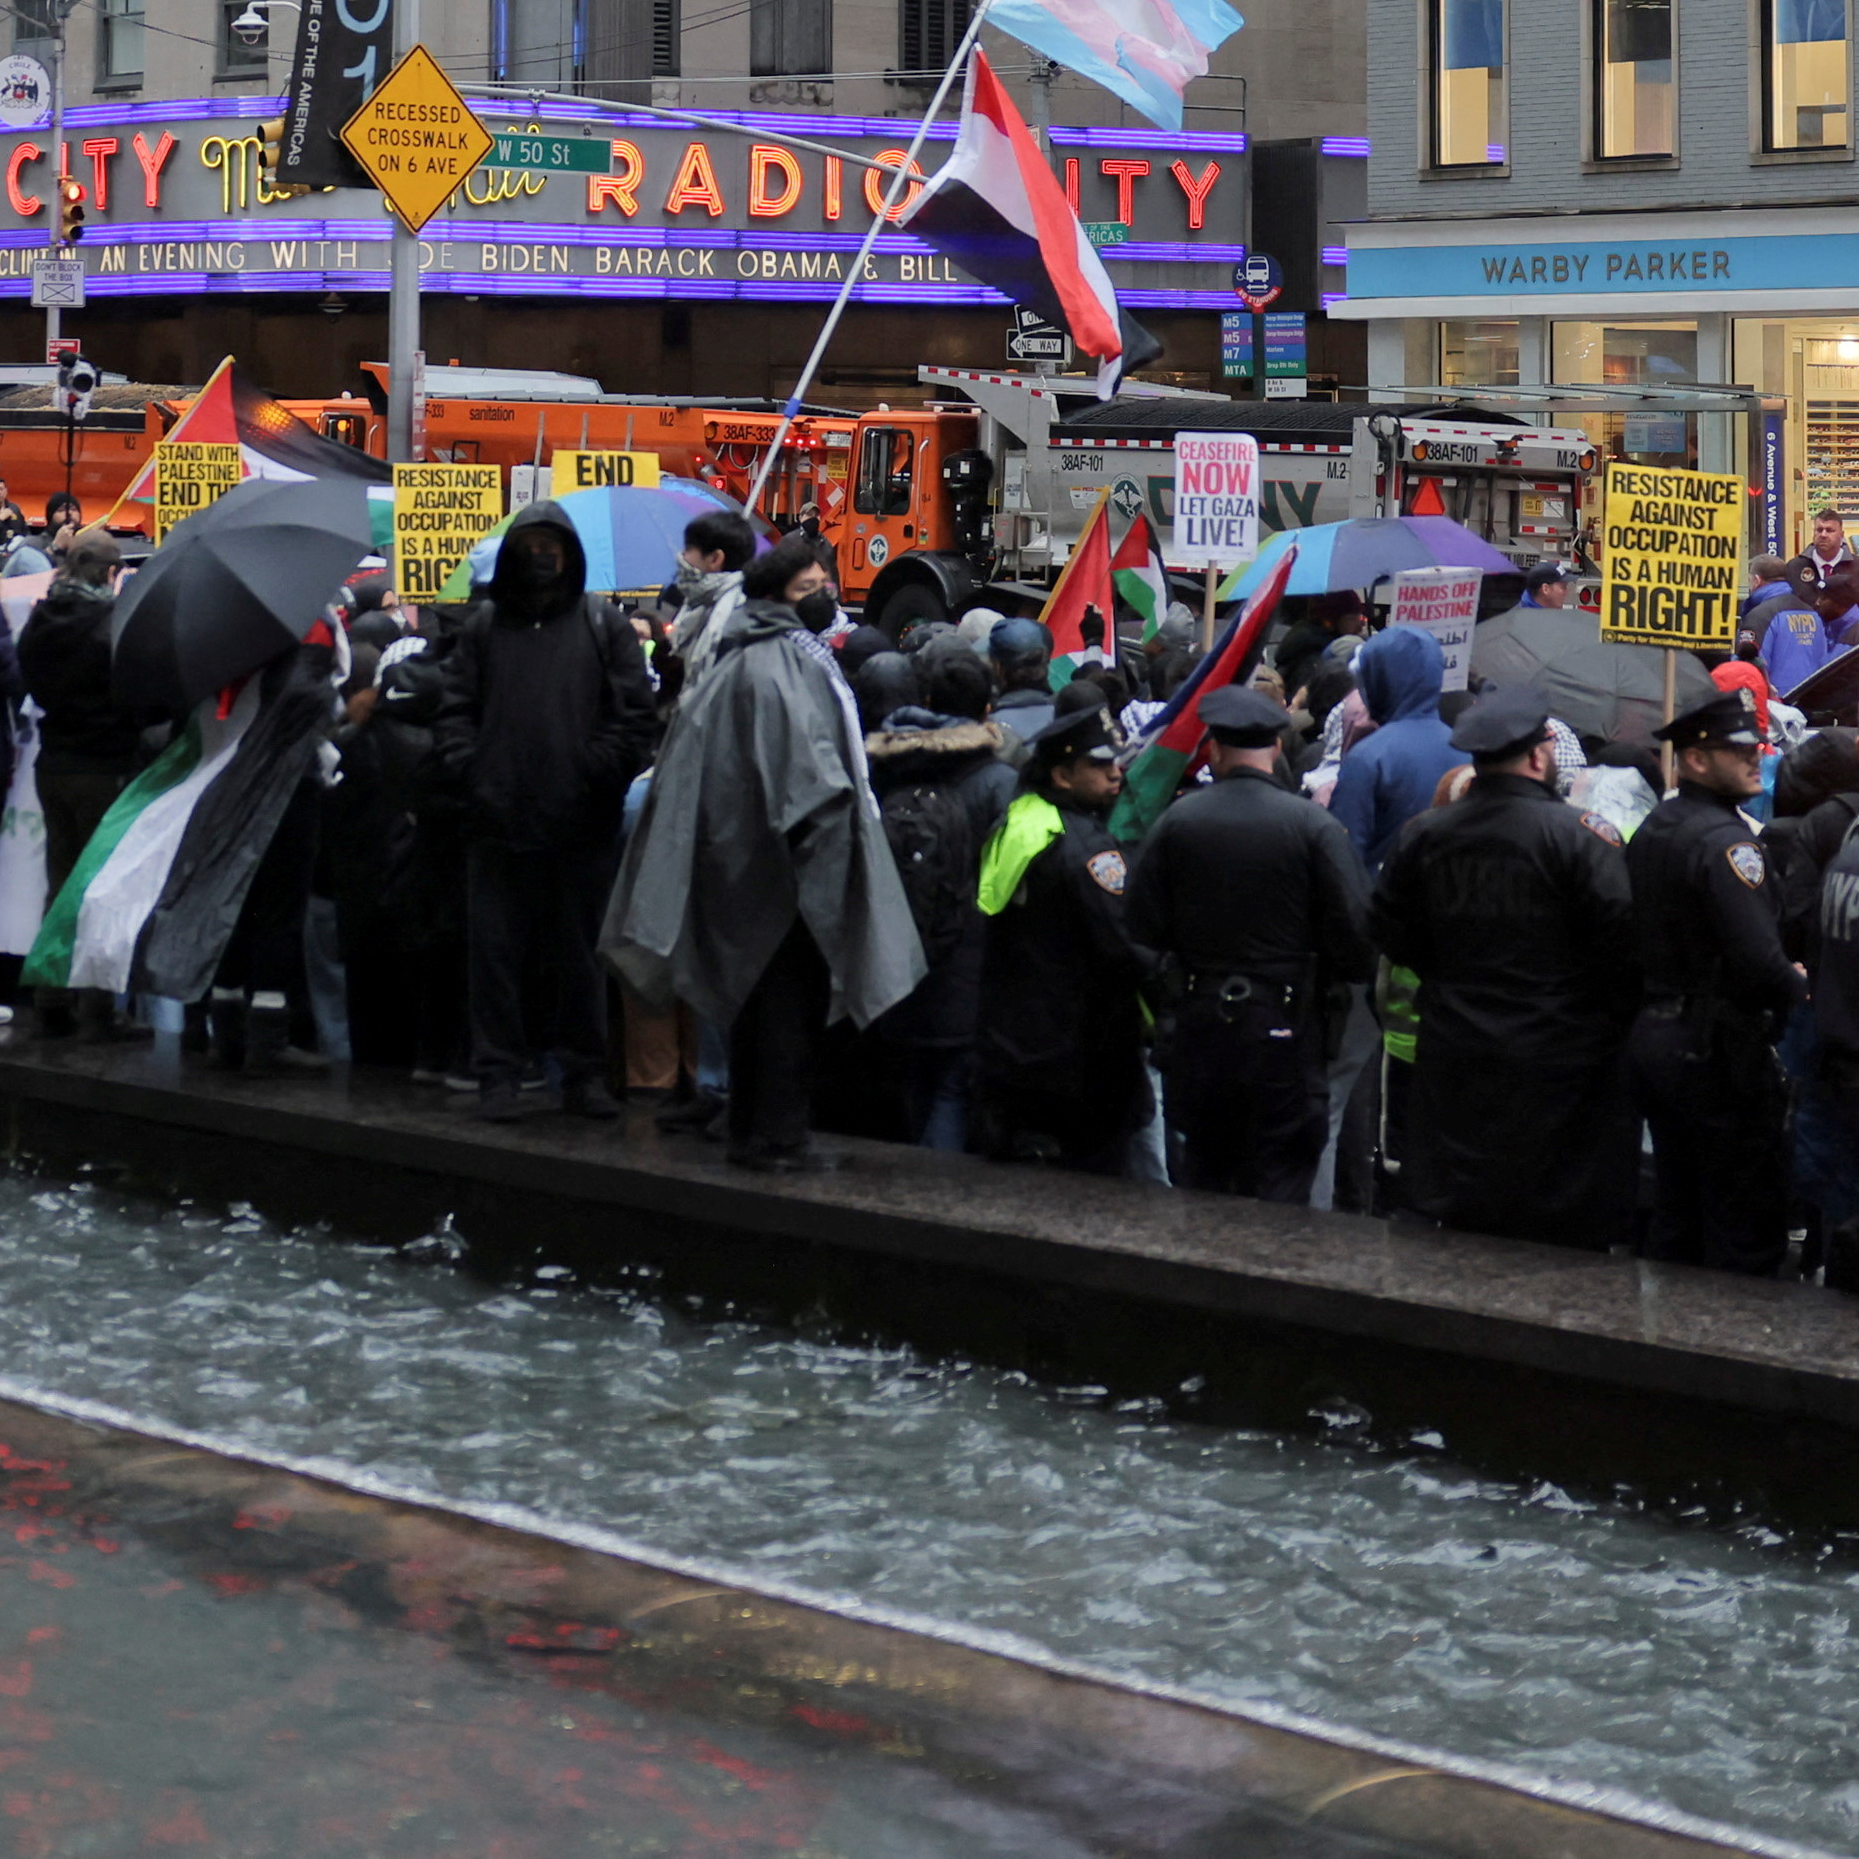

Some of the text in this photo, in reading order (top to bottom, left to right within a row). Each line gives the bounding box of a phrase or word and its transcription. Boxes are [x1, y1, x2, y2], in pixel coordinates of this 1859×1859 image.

[307, 18, 322, 42] OF
[9, 61, 32, 71] CHILE
[302, 44, 318, 78] THE
[287, 81, 312, 166] AMERICAS
[375, 102, 461, 124] RECESSED
[367, 128, 468, 150] CROSSWALK
[498, 140, 570, 166] W 50 St
[378, 154, 458, 176] ON 6 AVE
[586, 138, 925, 222] RADIO
[35, 262, 81, 273] DON'T BLOCK
[100, 246, 126, 272] AN
[139, 242, 246, 271] EVENING
[269, 240, 358, 270] WITH
[595, 246, 716, 277] BARACK
[737, 249, 842, 280] OBAMA
[863, 256, 879, 281] &
[900, 253, 958, 282] BILL
[1481, 250, 1731, 284] WARBY PARKER
[44, 273, 73, 282] THE BOX
[1247, 288, 1279, 304] STANDING
[1223, 315, 1240, 328] M5
[1015, 339, 1058, 352] ONE WAY
[1223, 331, 1240, 344] M5
[1223, 348, 1240, 360] M7
[1224, 364, 1247, 376] MTA
[469, 405, 675, 427] sanitation M.2
[723, 424, 776, 443] 38AF-333
[1766, 432, 1776, 441] 6
[158, 444, 239, 462] STAND WITH
[1179, 441, 1256, 461] CEASEFIRE
[1427, 443, 1577, 470] 38AF-101 M.2
[159, 463, 240, 481] PALESTINE!
[576, 454, 634, 487] END
[1061, 454, 1347, 480] 38AF-101 M.2
[1766, 443, 1776, 491] Avenue
[397, 469, 498, 489] RESISTANCE
[1182, 461, 1251, 496] NOW
[1612, 470, 1738, 505] RESISTANCE
[159, 482, 201, 506] END
[413, 490, 484, 510] AGAINST
[1767, 493, 1777, 504] &
[1180, 496, 1255, 518] LET GAZA
[1630, 500, 1718, 531] AGAINST
[397, 512, 499, 532] OCCUPATION
[1187, 517, 1244, 547] LIVE!
[1767, 506, 1777, 539] West
[402, 537, 433, 555] IS A
[1608, 525, 1737, 560] OCCUPATION
[1611, 557, 1734, 590] IS A HUMAN
[1398, 581, 1478, 602] HANDS OFF
[1395, 600, 1475, 622] PALESTINE
[1609, 583, 1731, 636] RIGHT!
[1787, 614, 1817, 633] NYPD
